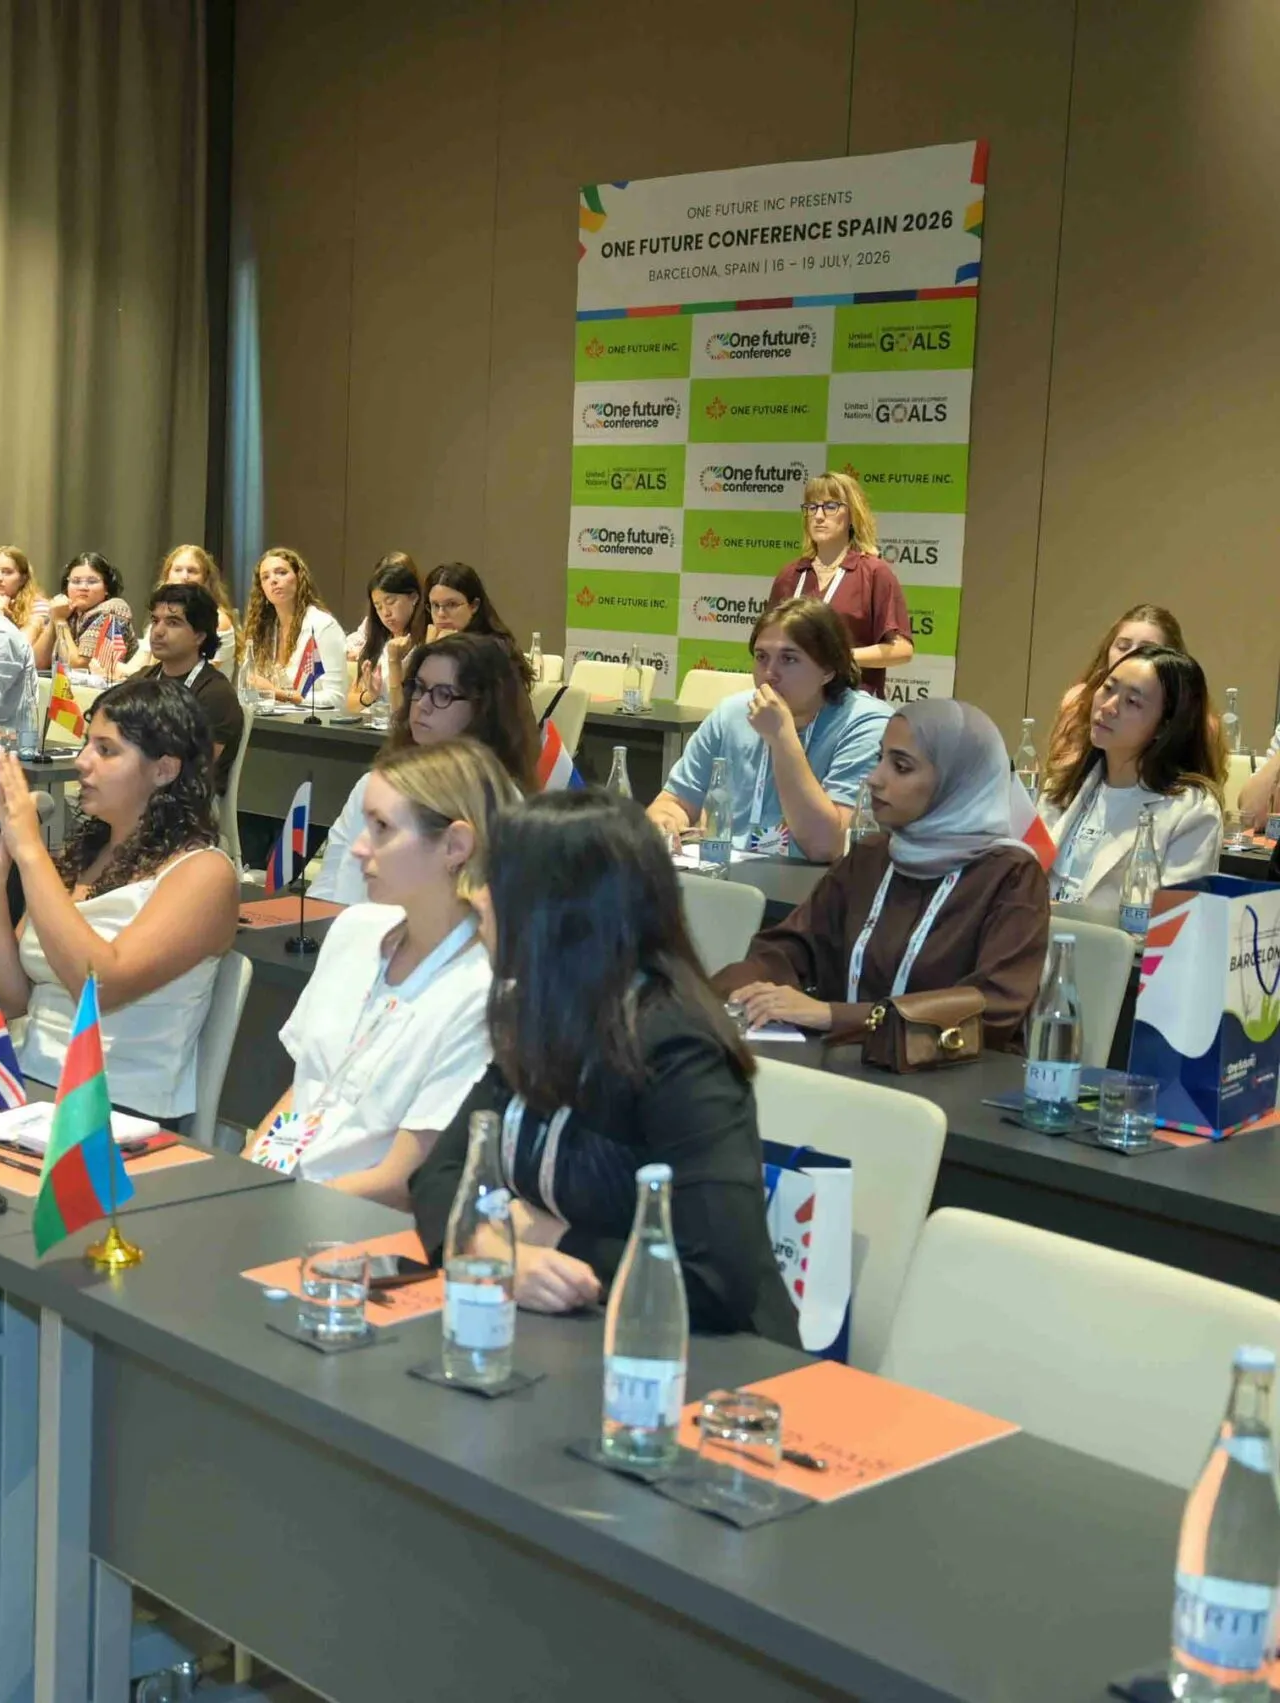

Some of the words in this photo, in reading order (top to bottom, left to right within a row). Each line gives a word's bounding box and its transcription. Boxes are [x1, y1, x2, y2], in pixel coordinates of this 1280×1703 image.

[687, 205, 711, 219] ONE
[715, 200, 759, 216] FUTURE
[764, 198, 785, 210] INC
[790, 191, 853, 208] PRESENTS
[601, 240, 635, 259] ONE
[639, 233, 704, 255] FUTURE
[708, 221, 832, 249] CONFERENCE
[838, 215, 898, 238] SPAIN
[902, 210, 953, 232] 2026
[725, 261, 760, 276] SPAIN
[772, 258, 785, 272] 16
[802, 256, 815, 270] 19
[819, 253, 853, 269] JULY,
[856, 250, 891, 266] 2026
[729, 332, 759, 347] One
[763, 330, 810, 346] future
[880, 331, 951, 352] GOALS
[608, 345, 626, 354] ONE
[628, 344, 661, 353] FUTURE
[729, 348, 792, 359] conference
[603, 402, 630, 417] One
[633, 401, 675, 416] future
[731, 406, 750, 415] ONE
[753, 405, 789, 415] FUTURE
[844, 402, 869, 410] United
[876, 403, 947, 423] GOALS
[844, 411, 871, 419] Nations
[603, 418, 659, 429] conference
[723, 465, 752, 481] One
[755, 464, 802, 482] future
[864, 474, 885, 483] ONE
[888, 474, 929, 483] FUTURE
[932, 474, 953, 483] INC.
[611, 473, 667, 490] GOALS
[723, 481, 784, 493] conference
[598, 528, 625, 543] One
[627, 529, 669, 544] future
[724, 538, 744, 548] ONE
[746, 538, 781, 549] FUTURE
[599, 544, 653, 555] conference
[598, 597, 615, 605] ONE
[617, 598, 648, 608] FUTURE
[716, 596, 746, 613] One
[748, 598, 765, 613] fut
[716, 613, 757, 625] confere
[891, 685, 929, 703] ALS
[1230, 945, 1280, 971] BARCELON
